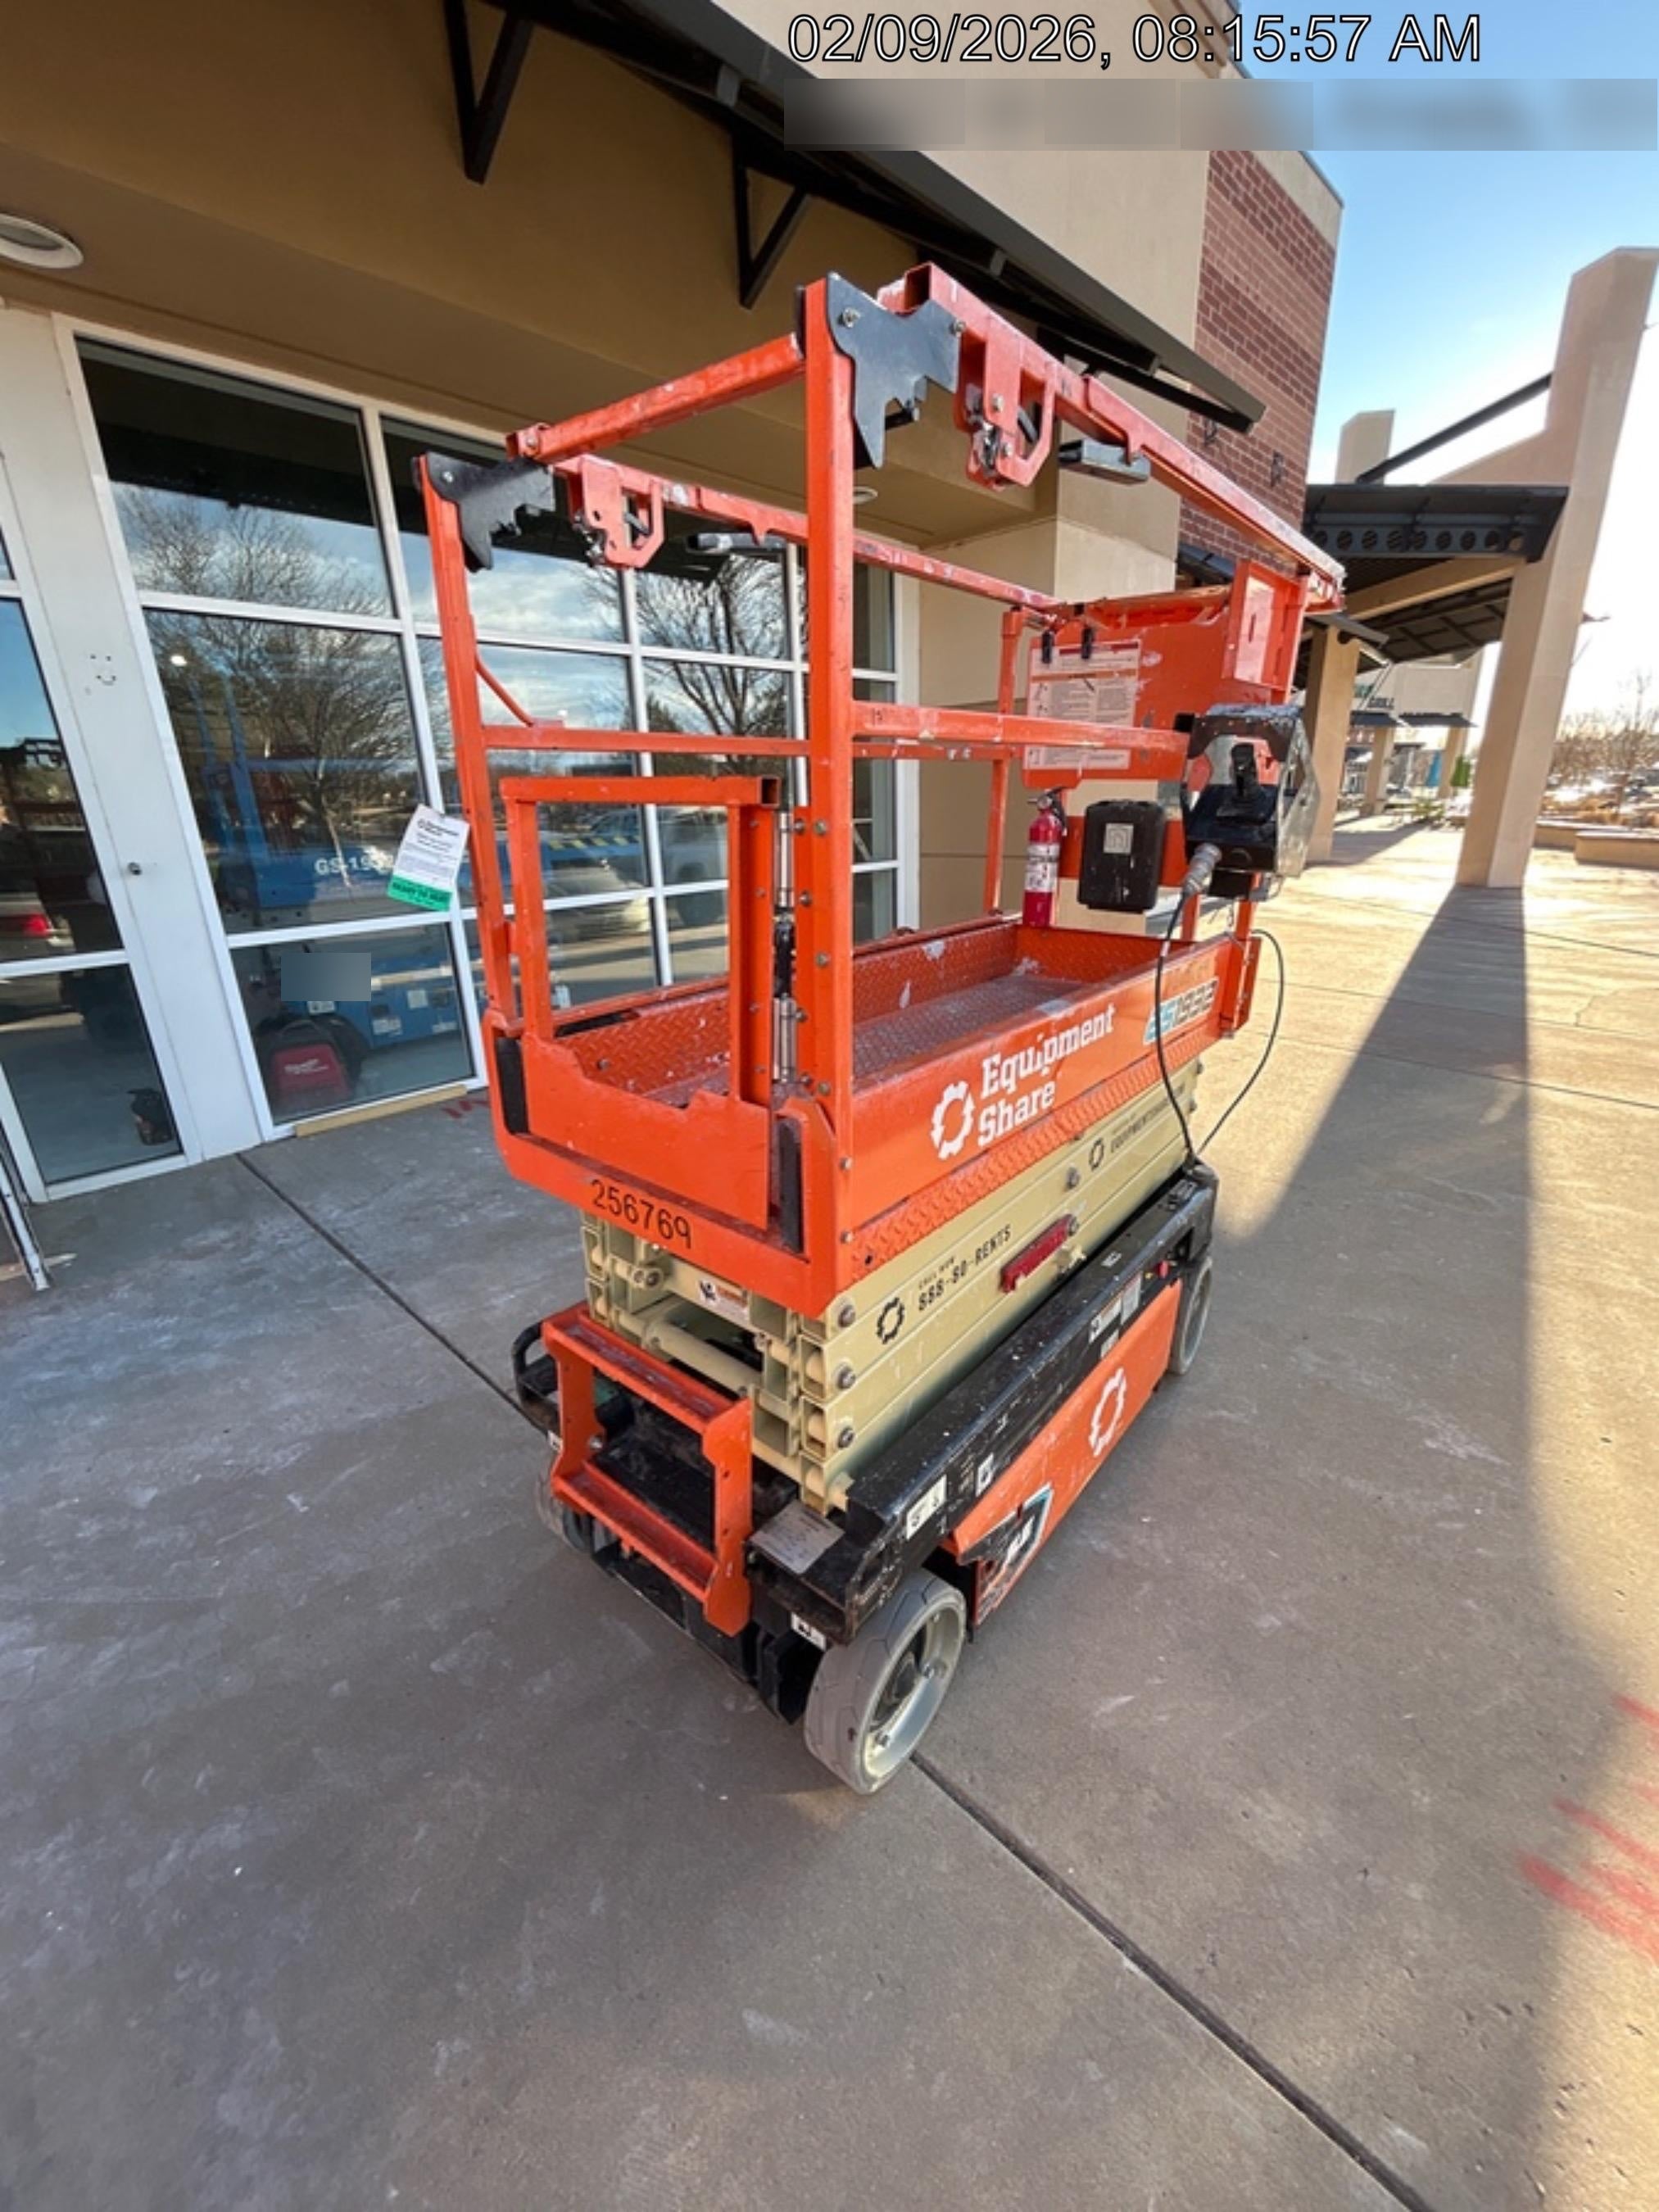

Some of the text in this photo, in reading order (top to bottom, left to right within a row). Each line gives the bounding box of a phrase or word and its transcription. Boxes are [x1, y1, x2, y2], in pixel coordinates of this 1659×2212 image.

[981, 1004, 1115, 1098] Equipment
[977, 1080, 1056, 1147] Share
[591, 1179, 692, 1249] 256769
